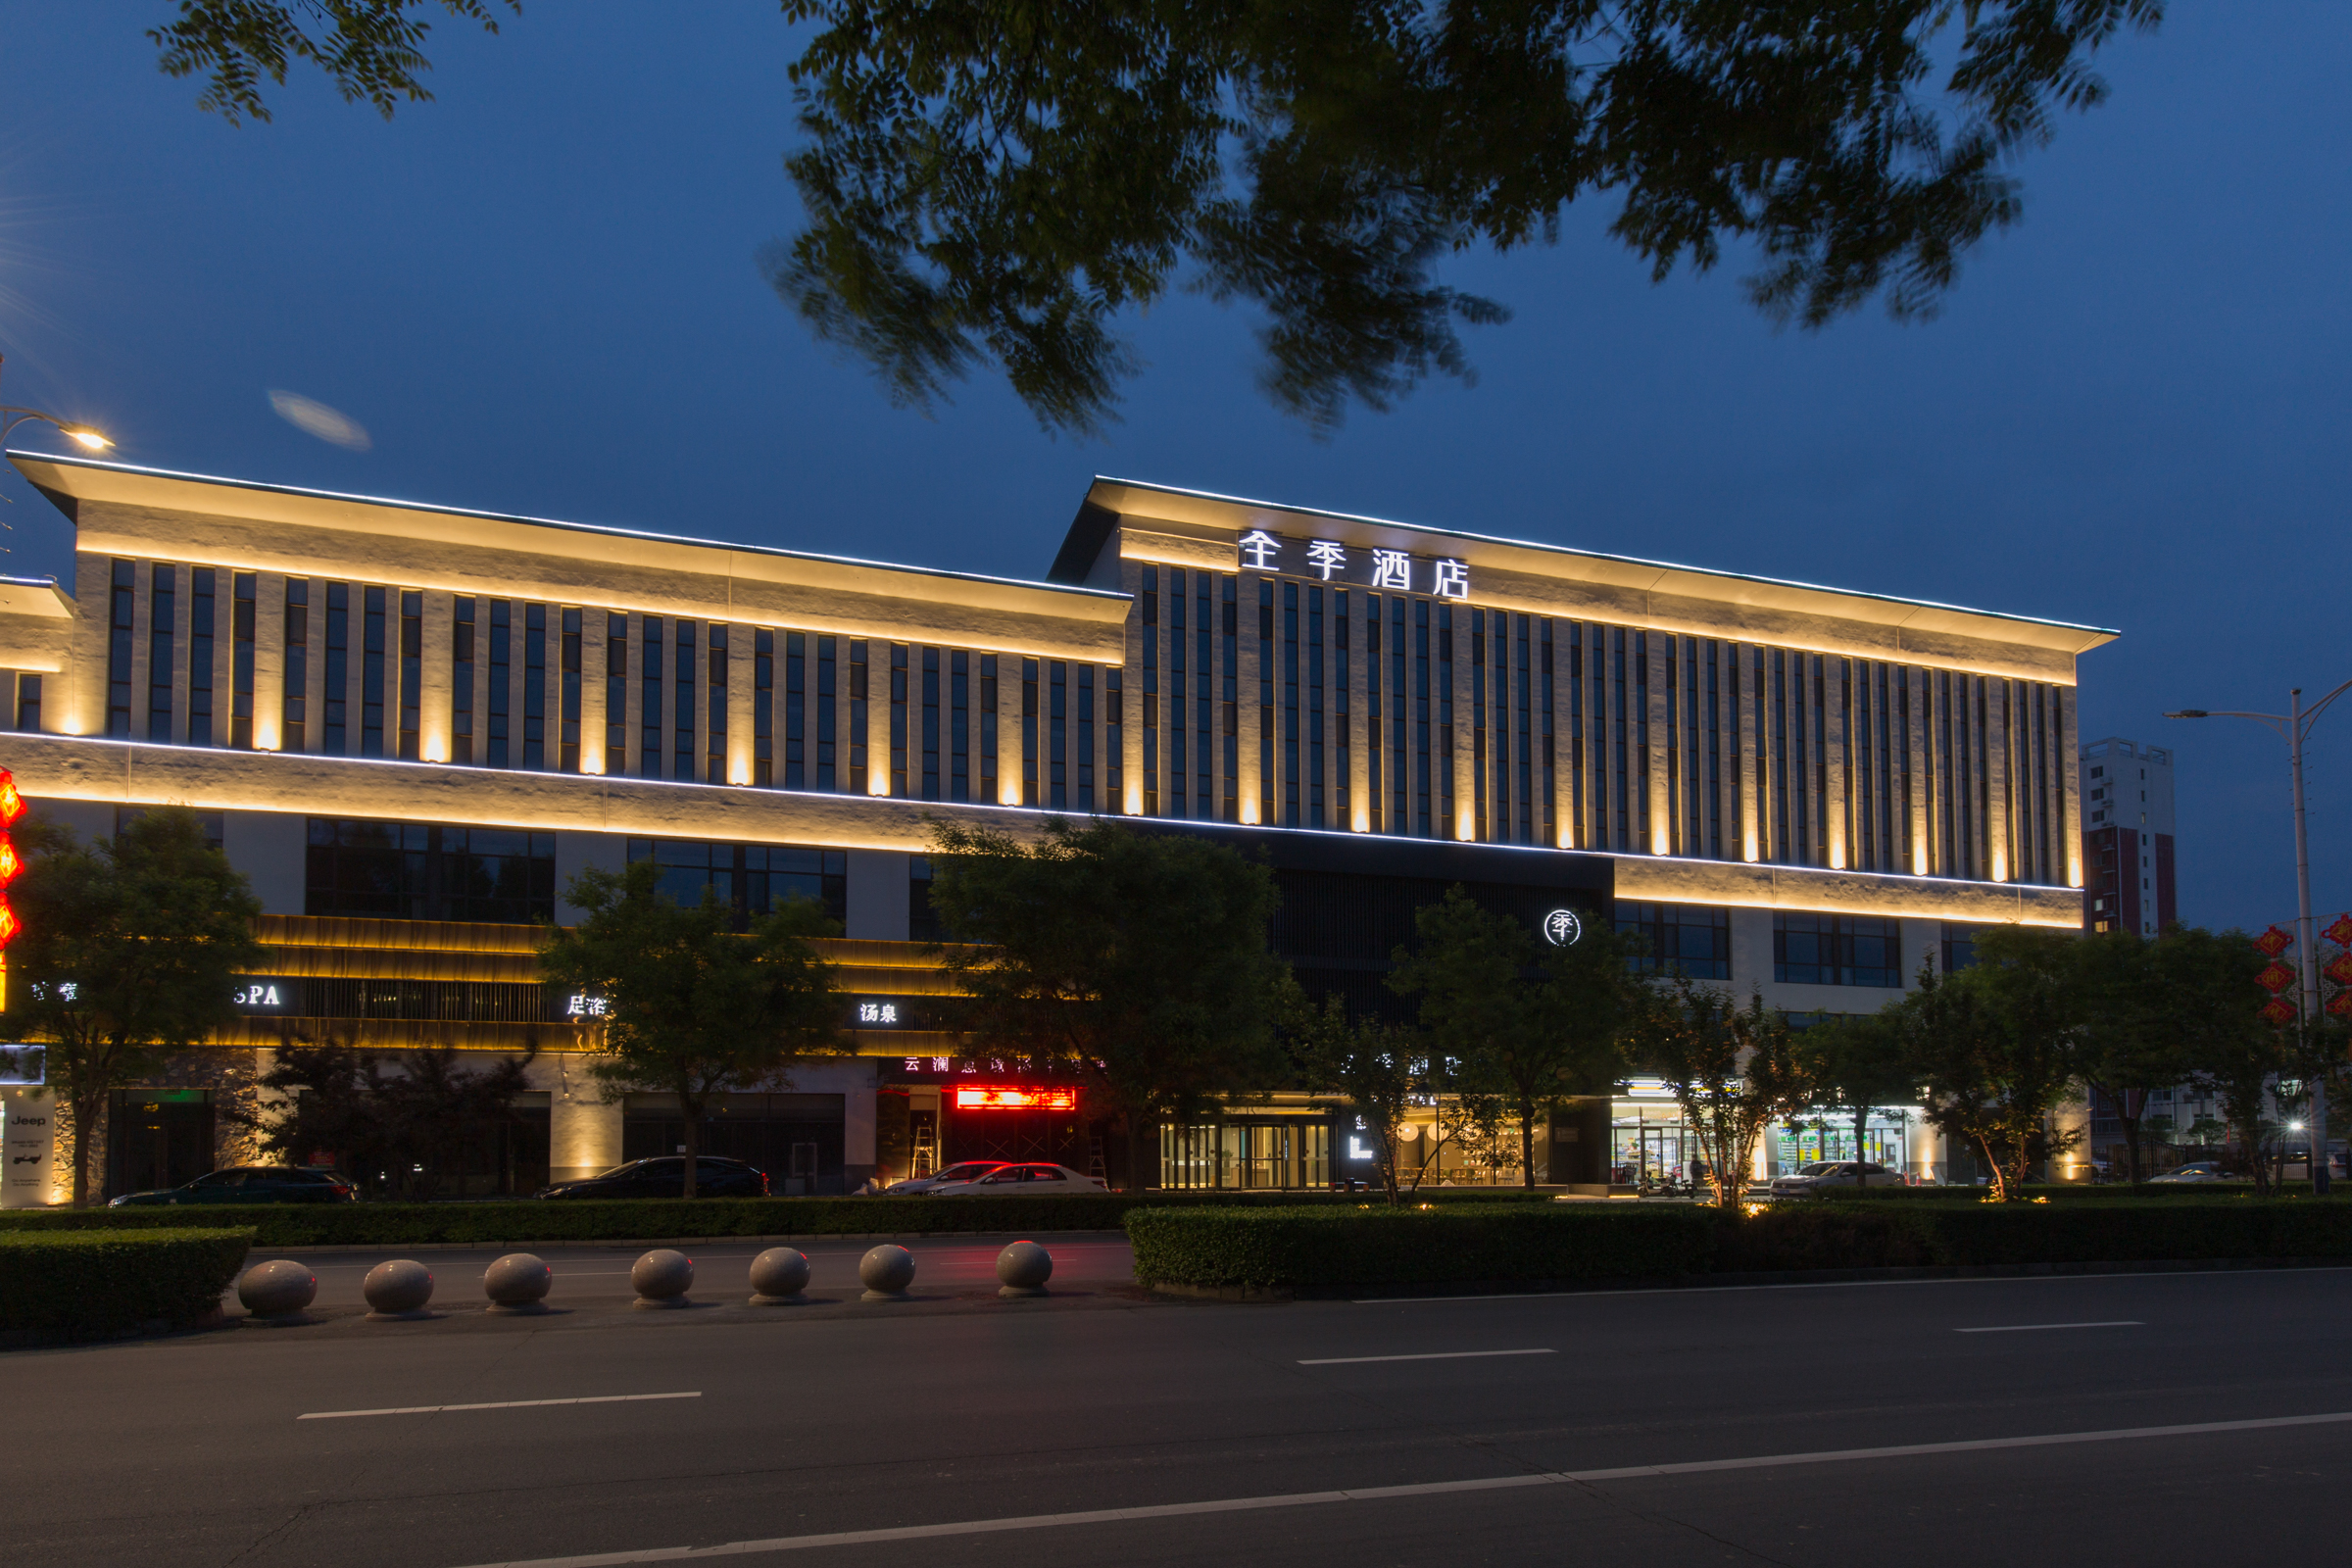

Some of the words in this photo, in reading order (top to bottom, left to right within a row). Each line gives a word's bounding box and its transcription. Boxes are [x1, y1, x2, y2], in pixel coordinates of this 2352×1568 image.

[1239, 530, 1469, 600] 全季酒店
[1550, 912, 1574, 943] 季
[860, 1004, 897, 1023] 汤泉
[11, 1115, 46, 1127] Jeep
